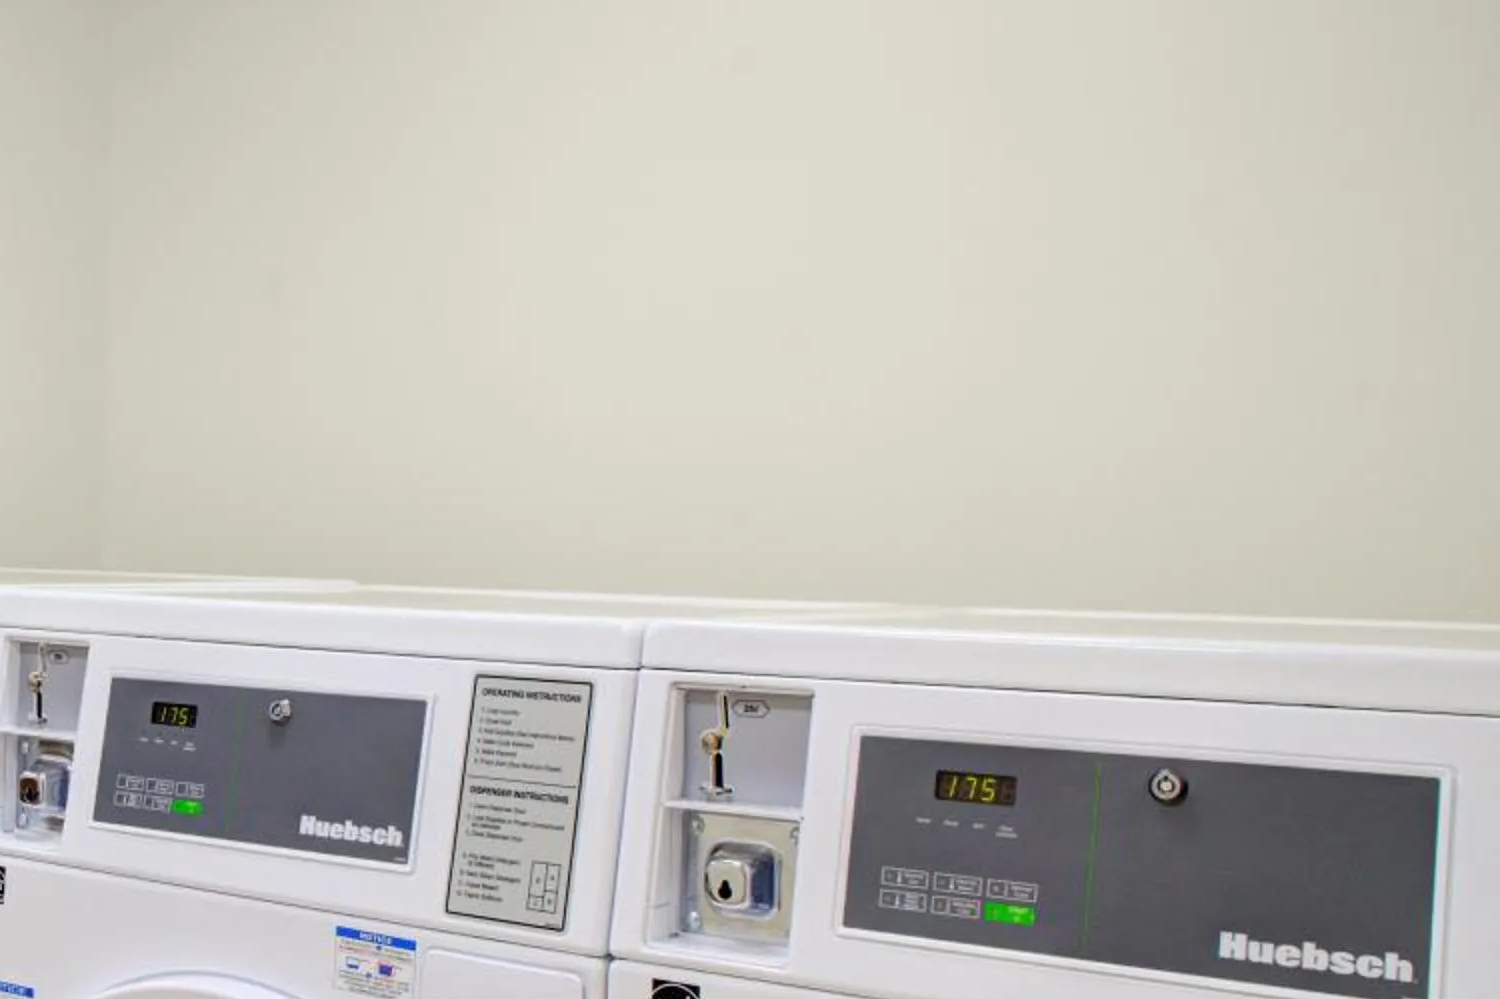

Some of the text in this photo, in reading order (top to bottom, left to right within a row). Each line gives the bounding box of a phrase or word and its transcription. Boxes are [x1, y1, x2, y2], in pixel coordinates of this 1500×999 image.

[160, 706, 189, 726] 175
[948, 774, 997, 803] 175
[299, 814, 404, 848] Huebsch
[1218, 930, 1415, 984] Huebsch
